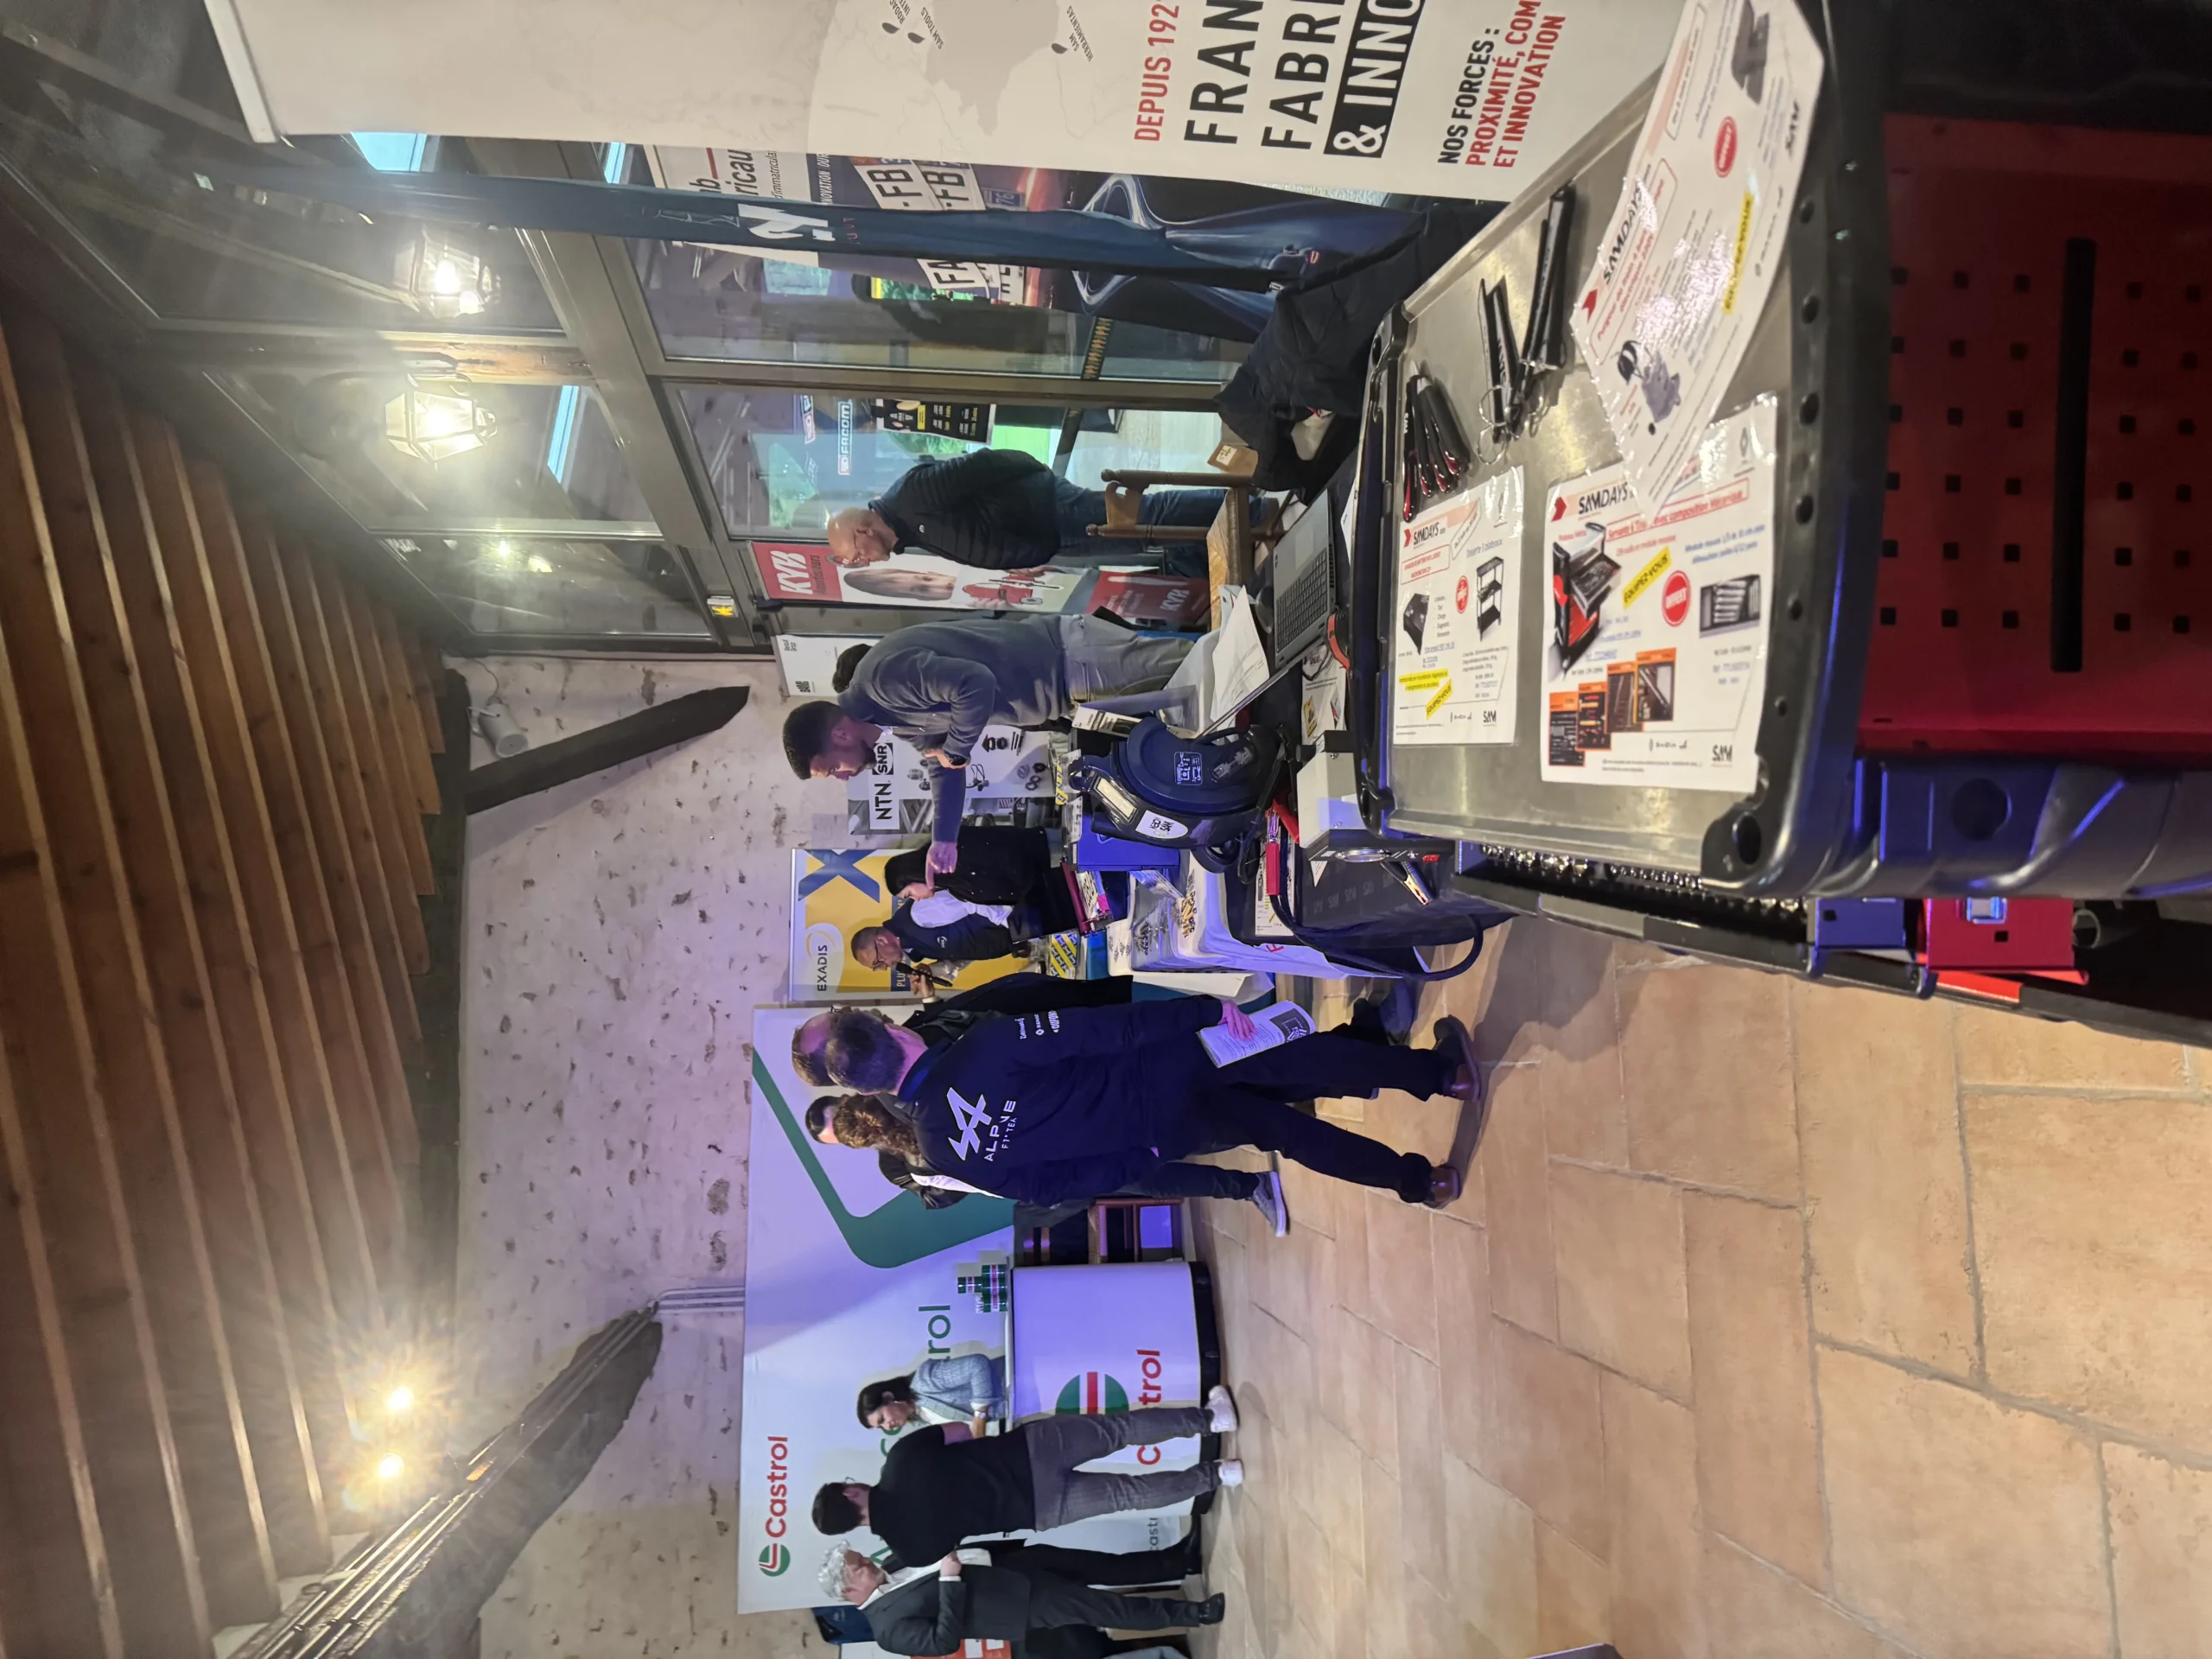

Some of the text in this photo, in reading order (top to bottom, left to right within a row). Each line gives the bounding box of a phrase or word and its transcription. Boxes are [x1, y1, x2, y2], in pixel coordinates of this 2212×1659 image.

[920, 7, 944, 50] SAM TOOLS
[1066, 5, 1094, 61] HERRAMIENTAS
[1069, 33, 1080, 51] SAM
[1134, 0, 1179, 142] DEPUIS 192
[1184, 0, 1264, 144] FRAN
[1332, 0, 1421, 154] & INNO
[1451, 40, 1495, 119] FORCES
[1492, 16, 1566, 168] ET INNOVATION
[1465, 51, 1526, 166] PROXIMITÉ,
[1437, 124, 1469, 164] NOS
[841, 404, 850, 454] FACOM
[1579, 481, 1628, 515] SAMDAYS
[770, 550, 813, 594] KYB
[874, 745, 893, 819] NTN SNR
[817, 944, 827, 991] EXADIS
[896, 972, 906, 987] PLU
[983, 1100, 1016, 1161] ALPNE
[1136, 1349, 1161, 1465] Ctrol
[765, 1436, 788, 1538] Castrol
